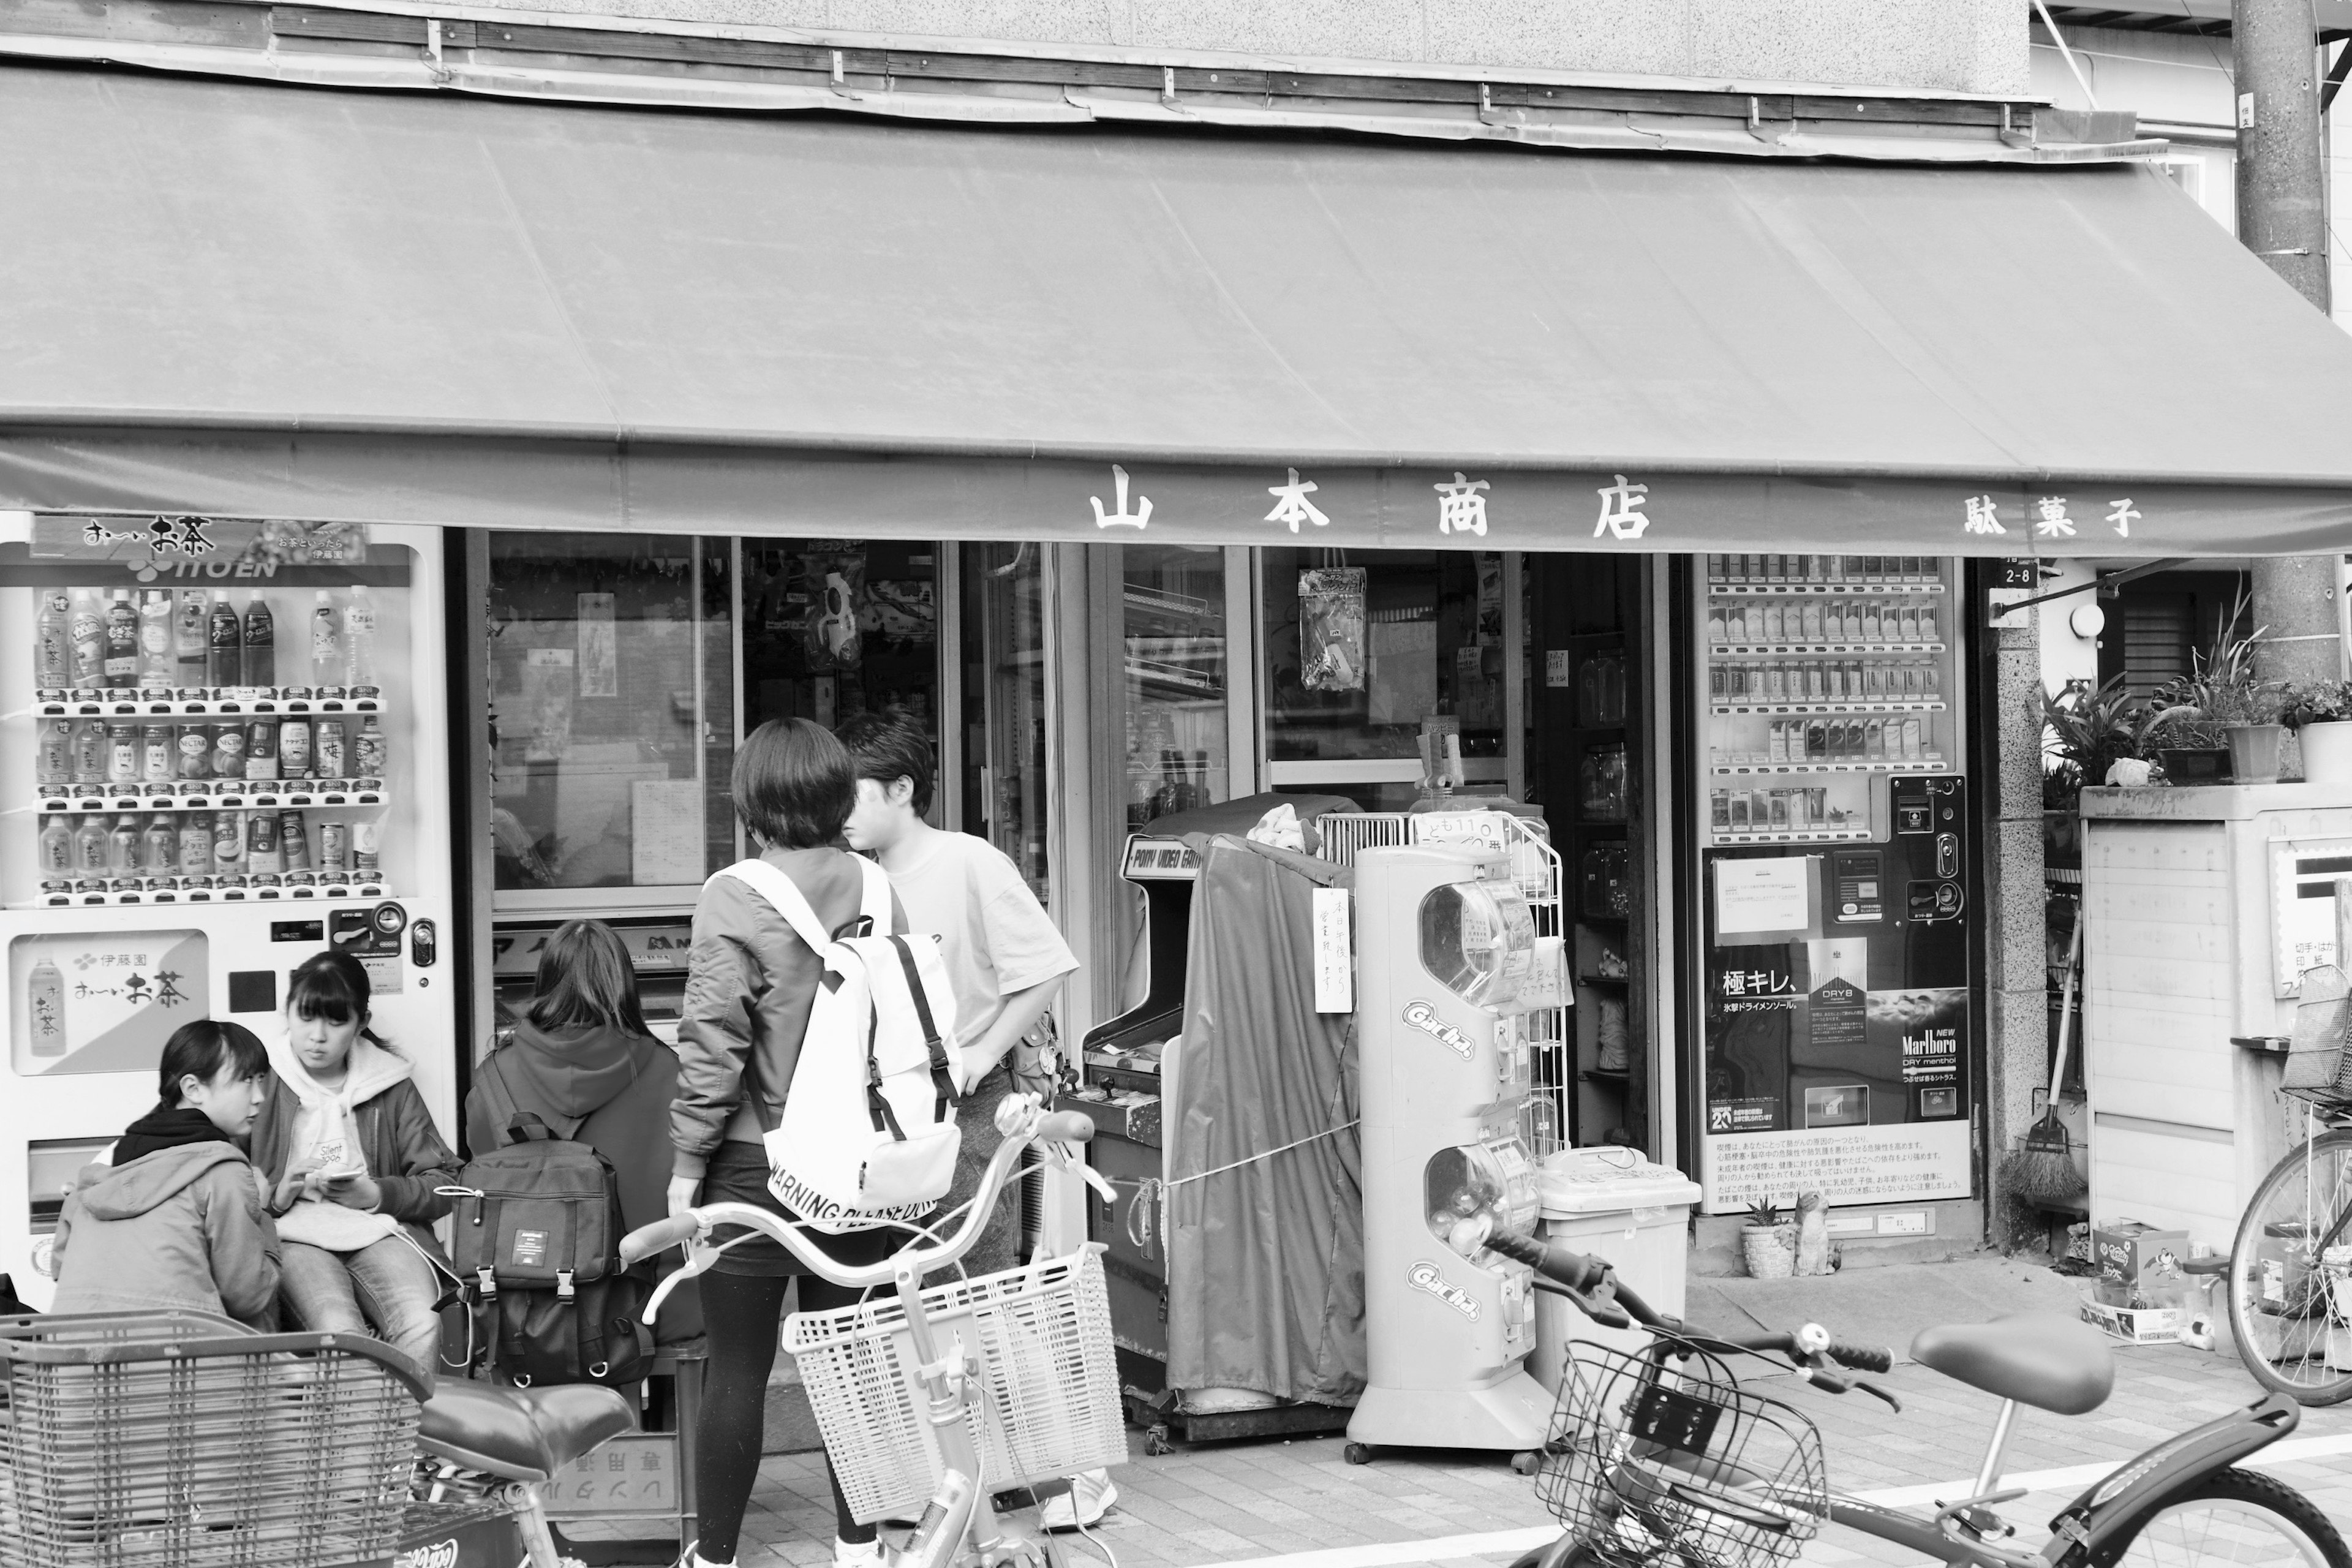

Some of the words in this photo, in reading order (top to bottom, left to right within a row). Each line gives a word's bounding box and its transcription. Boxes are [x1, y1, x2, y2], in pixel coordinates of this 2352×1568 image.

[1090, 464, 1649, 540] 山本商店
[1964, 494, 2141, 537] 駄菓子
[279, 538, 343, 548] お茶といったら
[313, 551, 343, 559] 伊藤園
[235, 562, 276, 578] EN
[2006, 569, 2030, 582] 2-8
[1133, 849, 1156, 868] PONY
[1157, 849, 1181, 868] VIDEO
[1333, 901, 1348, 995] 本日午後から
[100, 954, 146, 967] 伊藤園
[2296, 955, 2323, 967] 印紙
[1723, 970, 1796, 996] 極キレ、
[1724, 1000, 1797, 1012] 氷撃ドライメンソール。
[1902, 1029, 1956, 1055] Marlboro
[1713, 1112, 1732, 1129] 20
[770, 1157, 841, 1221] WARNING
[541, 1480, 662, 1501] レンタル
